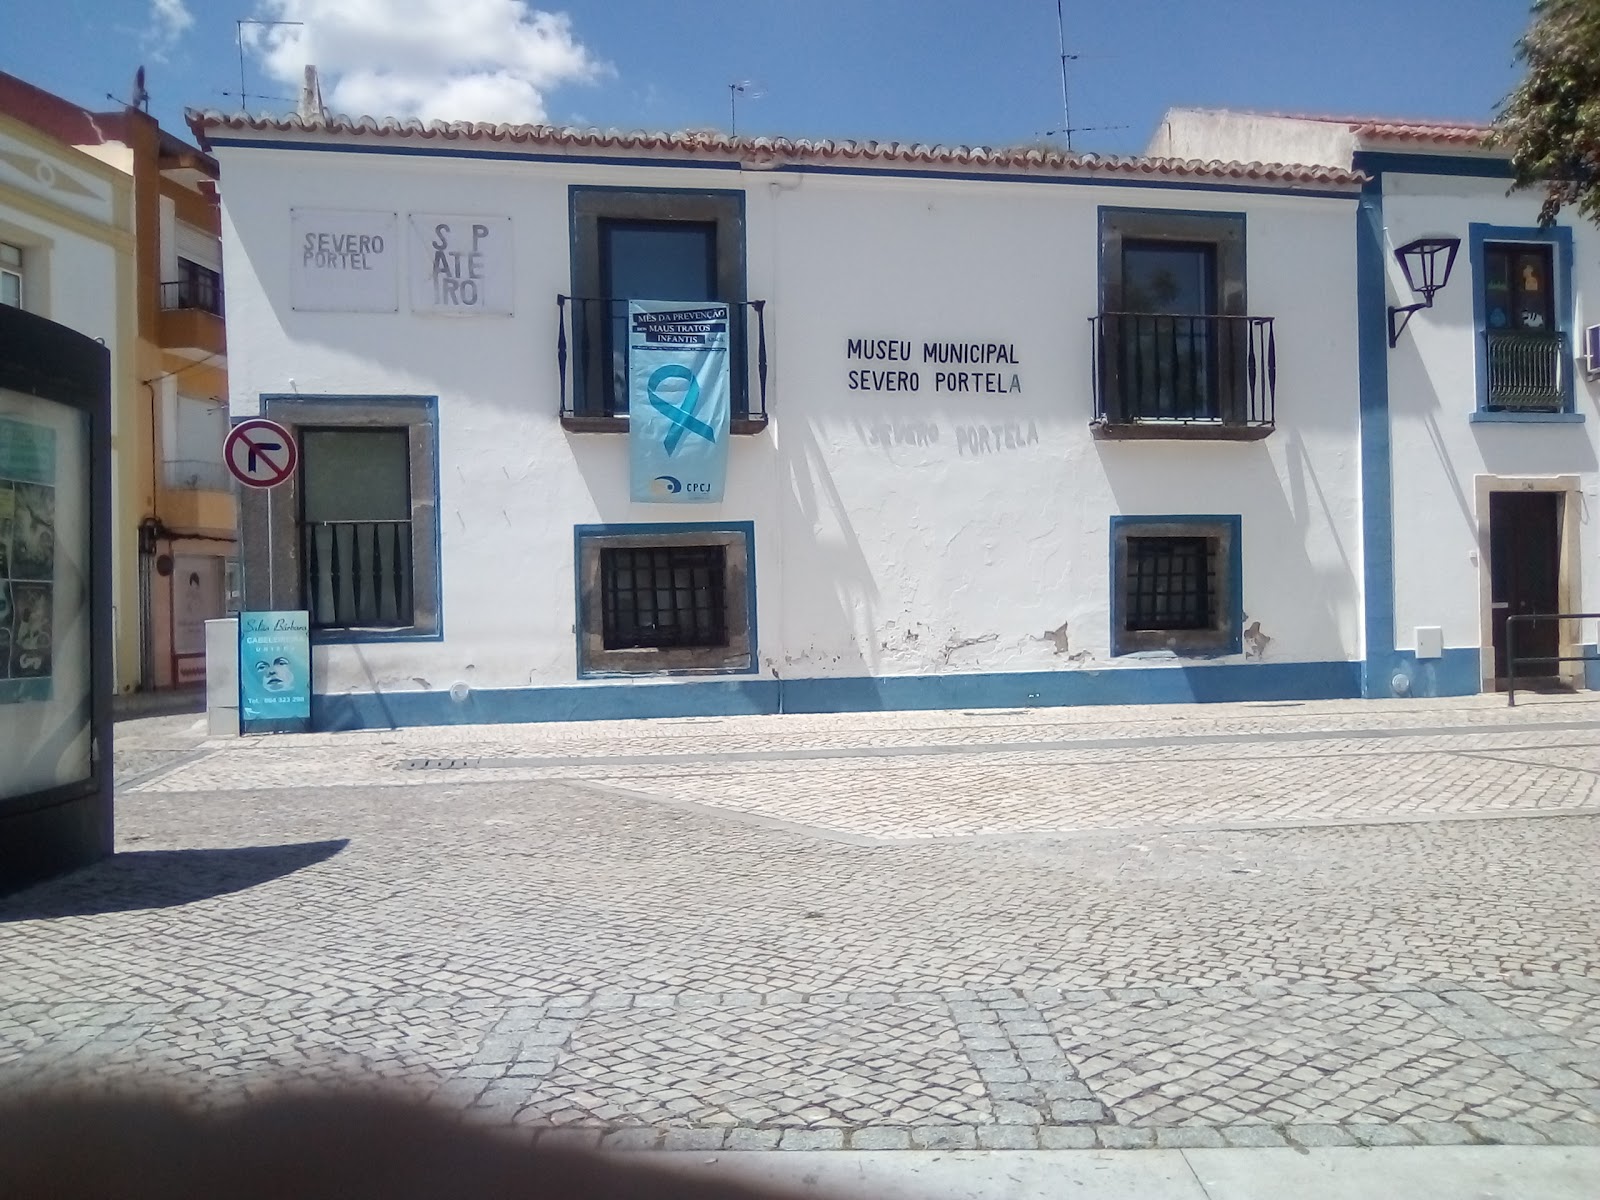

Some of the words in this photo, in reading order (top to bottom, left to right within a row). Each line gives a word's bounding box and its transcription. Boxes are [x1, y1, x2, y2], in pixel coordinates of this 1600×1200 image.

[303, 232, 384, 254] SEVERO
[303, 250, 372, 270] PORTEL
[638, 313, 657, 323] MÊS
[658, 314, 671, 322] DA
[673, 308, 725, 321] PREVENÇÃO
[649, 324, 674, 333] MAUS
[675, 324, 711, 333] TRATOS
[657, 334, 698, 344] INFANTIS
[847, 338, 911, 361] MUSEU
[923, 342, 1019, 364] MUNICIPAL
[848, 370, 919, 392] SEVERO
[935, 372, 1022, 393] PORTELA
[686, 482, 711, 492] CPCJ
